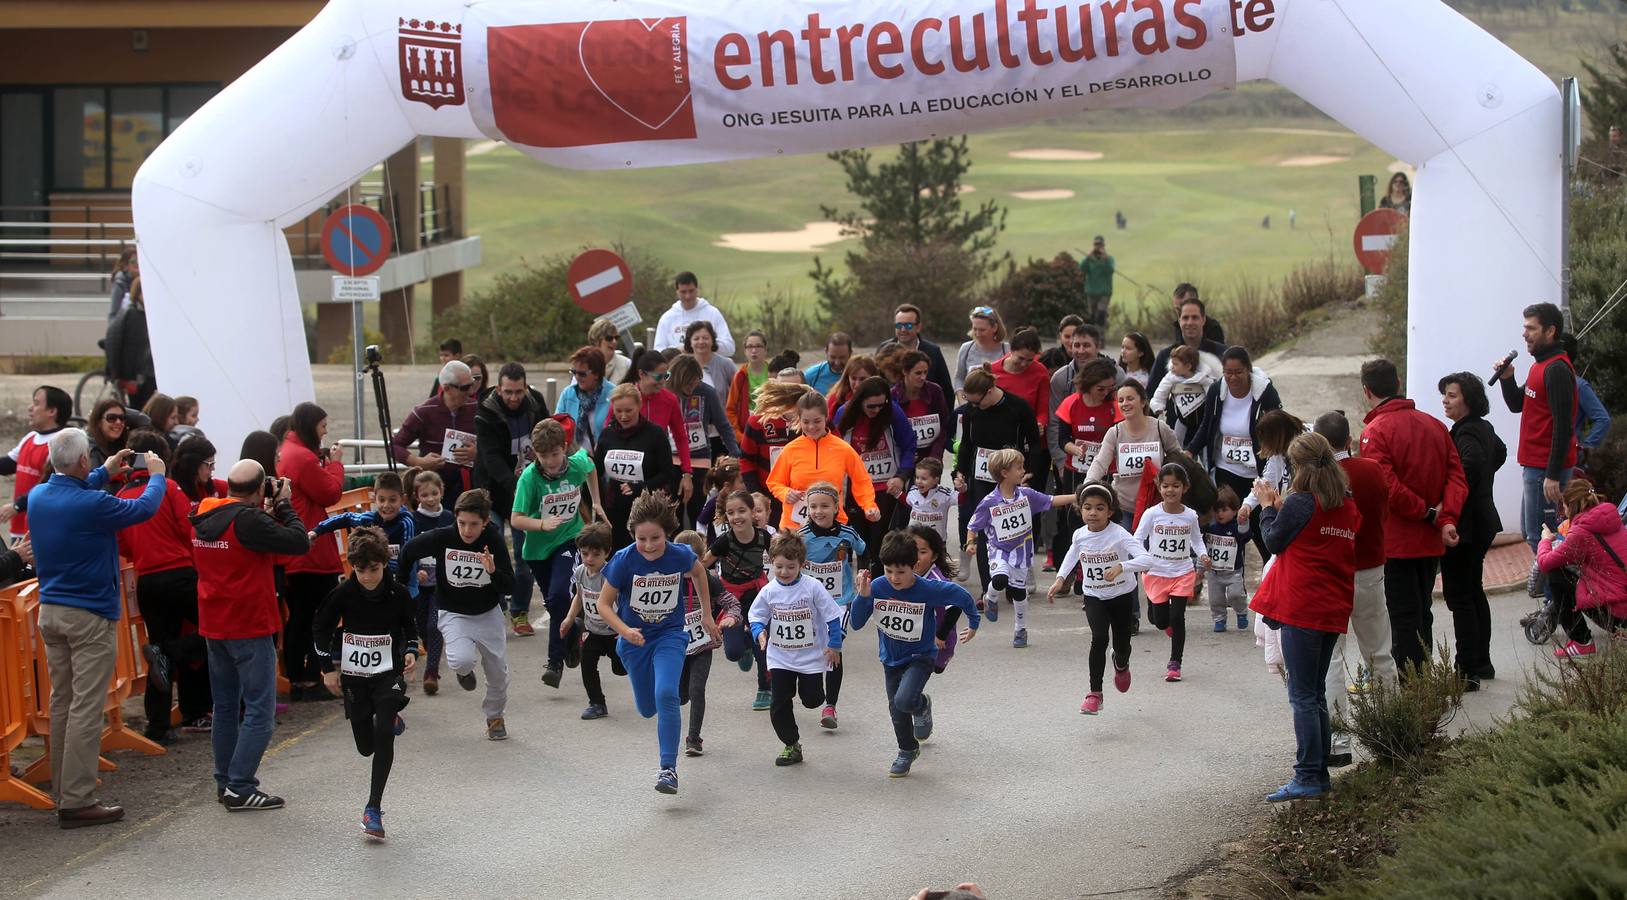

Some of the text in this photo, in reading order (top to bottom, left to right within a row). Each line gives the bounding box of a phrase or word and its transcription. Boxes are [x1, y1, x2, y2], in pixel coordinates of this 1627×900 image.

[671, 22, 681, 63] ALEGRÍA
[714, 0, 1208, 91] entreculturas
[675, 74, 683, 84] FE
[722, 68, 1212, 128] ONG JESUITA PARA LA EDUCACIÓN Y EL DESARROLLO
[1227, 450, 1250, 462] 433
[611, 463, 636, 475] 472
[868, 462, 891, 475] 417
[548, 502, 576, 516] 476
[1002, 513, 1026, 530] 481
[1159, 539, 1185, 552] 434
[1208, 548, 1229, 562] 484
[452, 566, 484, 580] 427
[1087, 567, 1111, 581] 43
[639, 590, 672, 605] 407
[586, 602, 599, 614] 41
[888, 605, 923, 615] ATLETISMO
[778, 613, 810, 622] ATLETISMO
[880, 616, 914, 632] 480
[688, 625, 704, 644] 13
[777, 625, 805, 640] 418
[356, 640, 390, 648] ATLETISMO
[349, 651, 382, 667] 409
